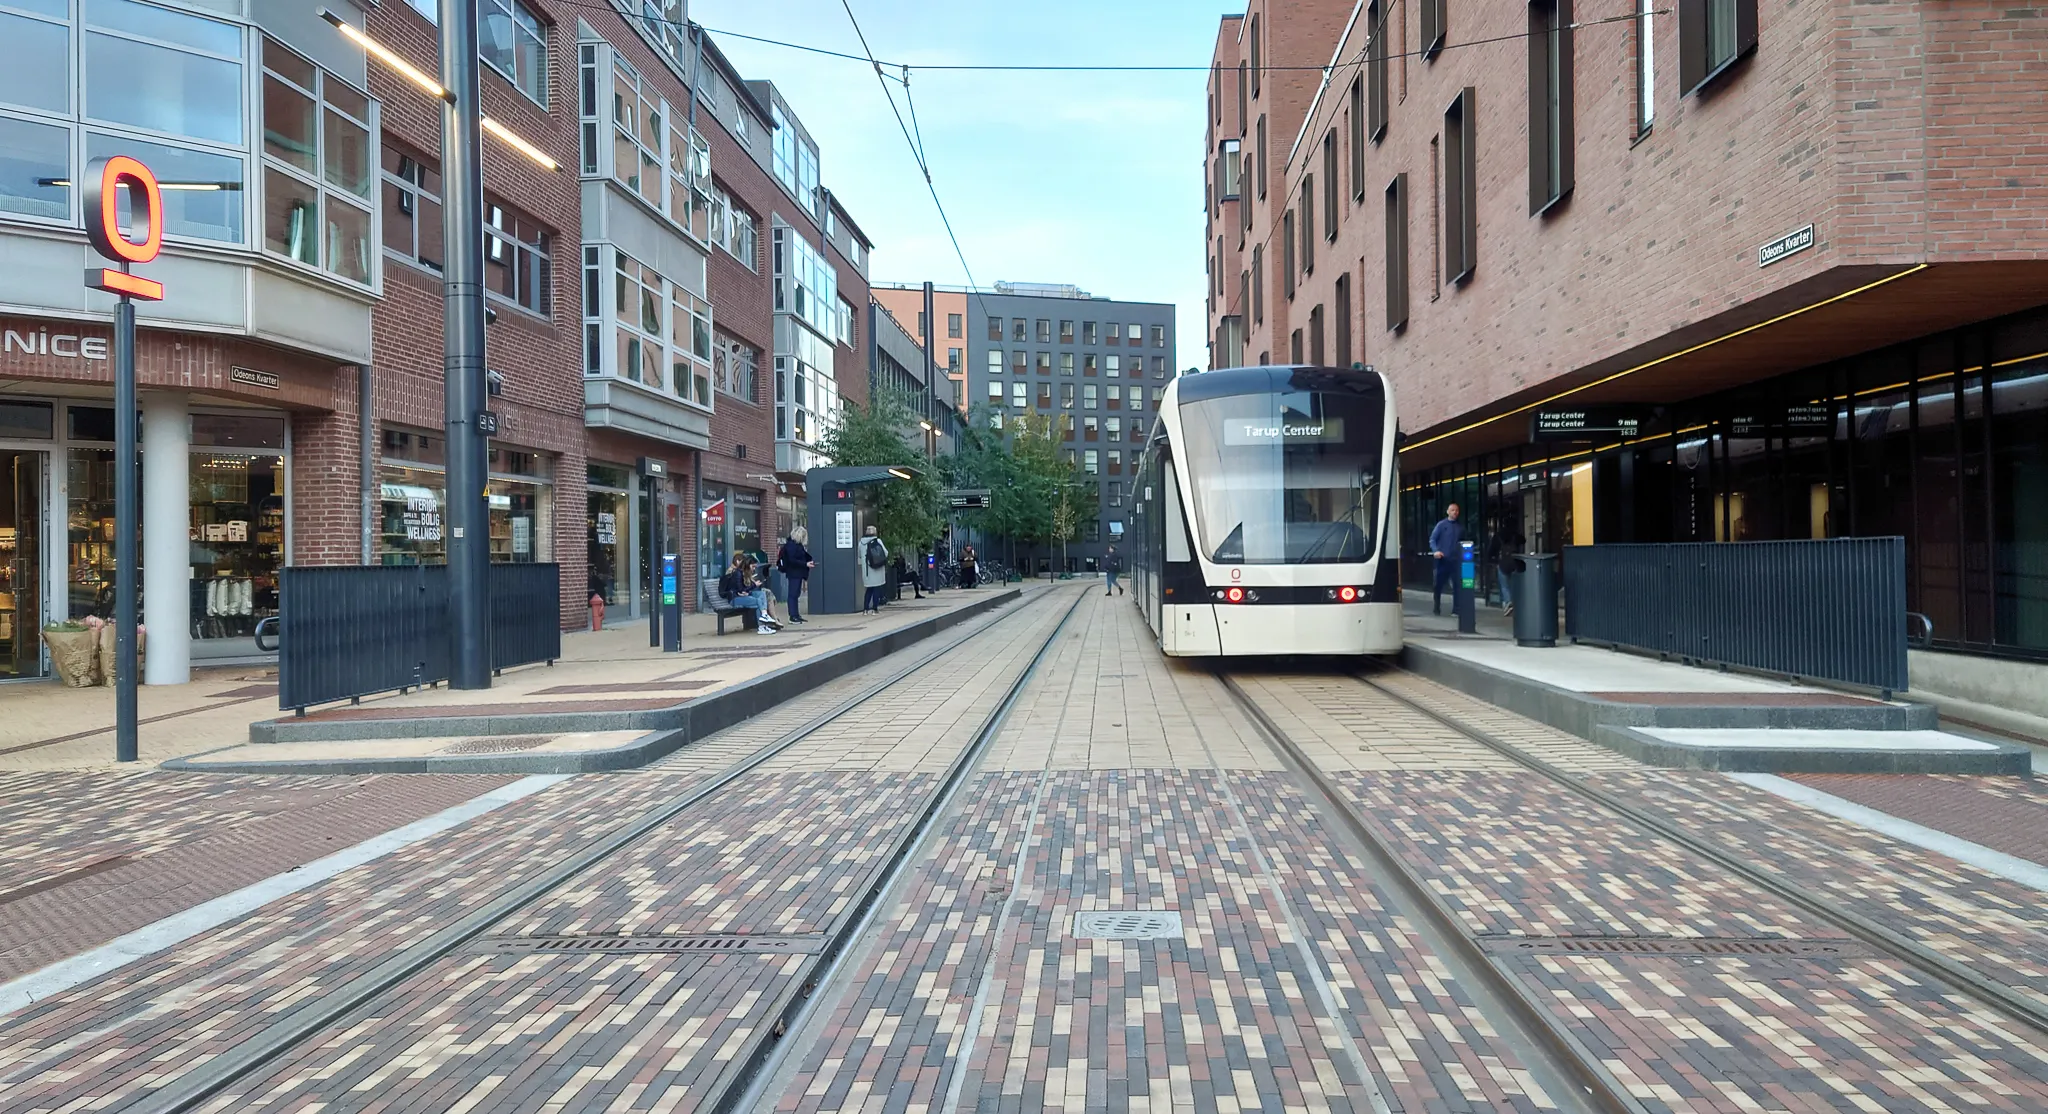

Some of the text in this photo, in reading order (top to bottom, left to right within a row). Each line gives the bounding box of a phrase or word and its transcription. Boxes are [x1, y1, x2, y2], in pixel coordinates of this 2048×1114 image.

[1762, 231, 1810, 261] Odeons Kvarter
[233, 368, 277, 385] Odeons Kvarter
[1539, 412, 1561, 420] Tarup
[1243, 423, 1324, 438] Tarup Center
[1539, 420, 1561, 428] Tarup
[407, 497, 437, 512] INTERIOR
[421, 512, 440, 526] BOLIG
[407, 525, 441, 540] WELLNESS
